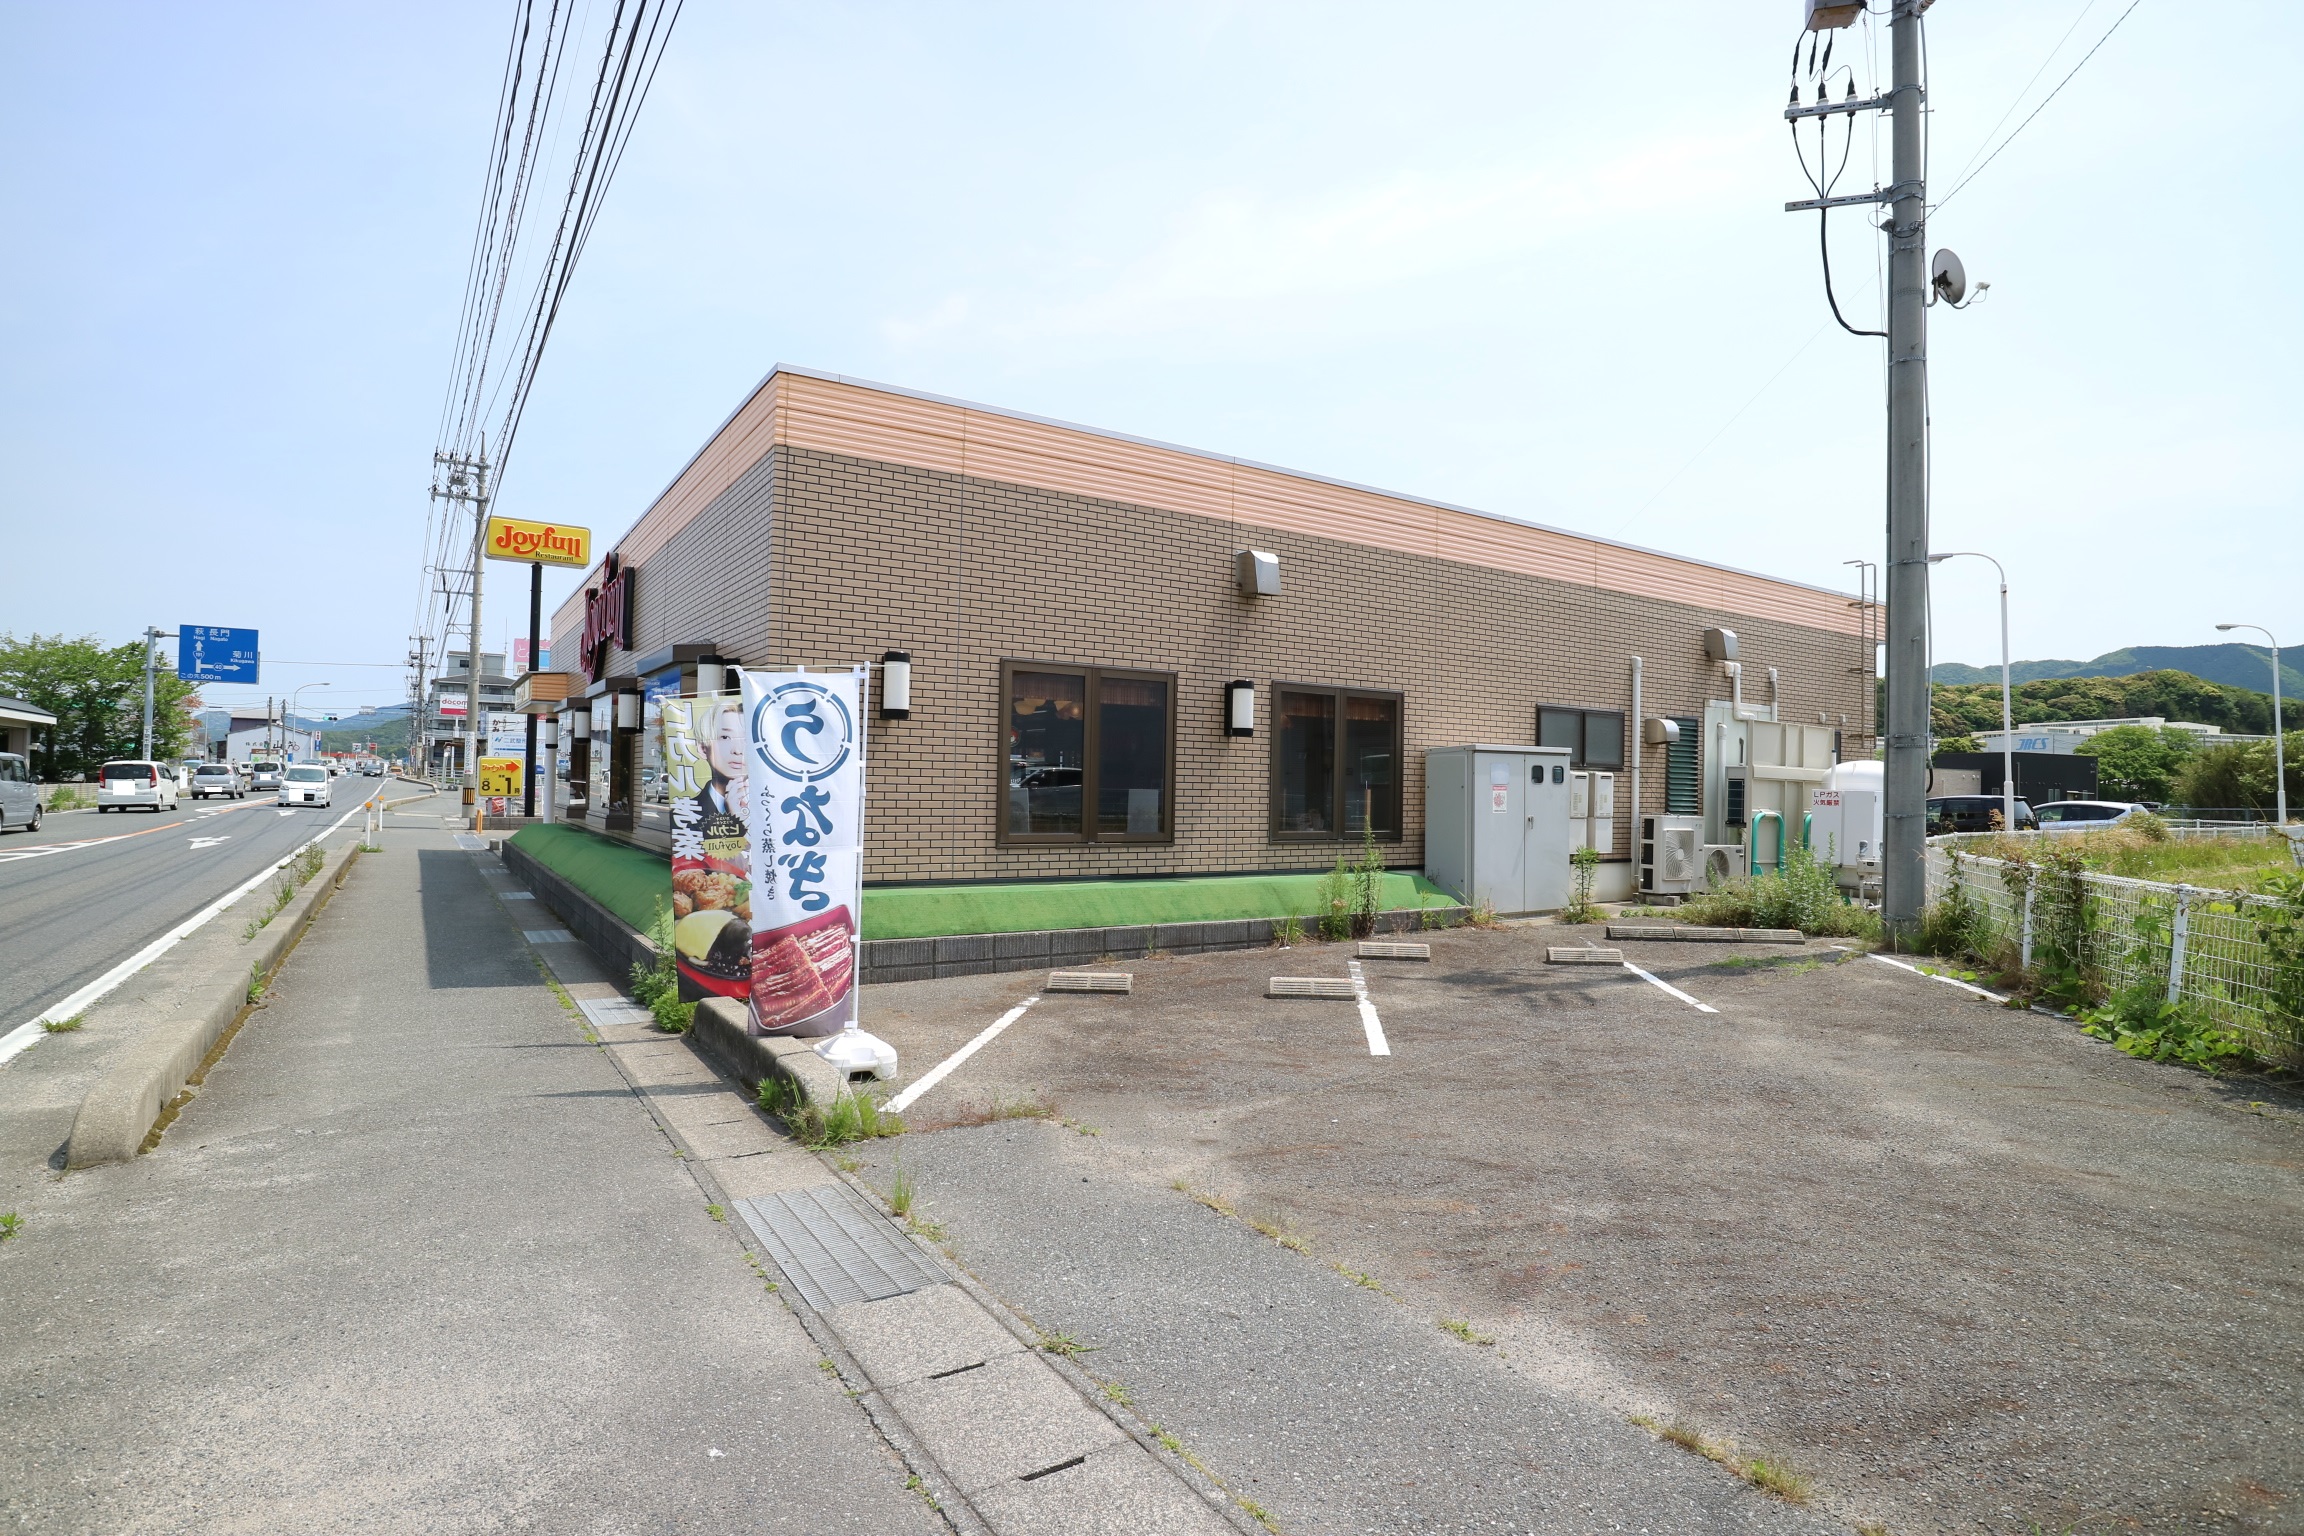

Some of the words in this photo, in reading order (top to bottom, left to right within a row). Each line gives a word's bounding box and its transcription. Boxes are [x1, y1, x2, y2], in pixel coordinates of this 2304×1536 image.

[495, 525, 582, 558] Joyfull
[535, 551, 574, 562] Restaurant
[209, 628, 230, 637] 長門
[232, 650, 253, 659] 菊川
[441, 698, 468, 706] docom
[481, 780, 491, 791] 8
[505, 777, 512, 794] 1
